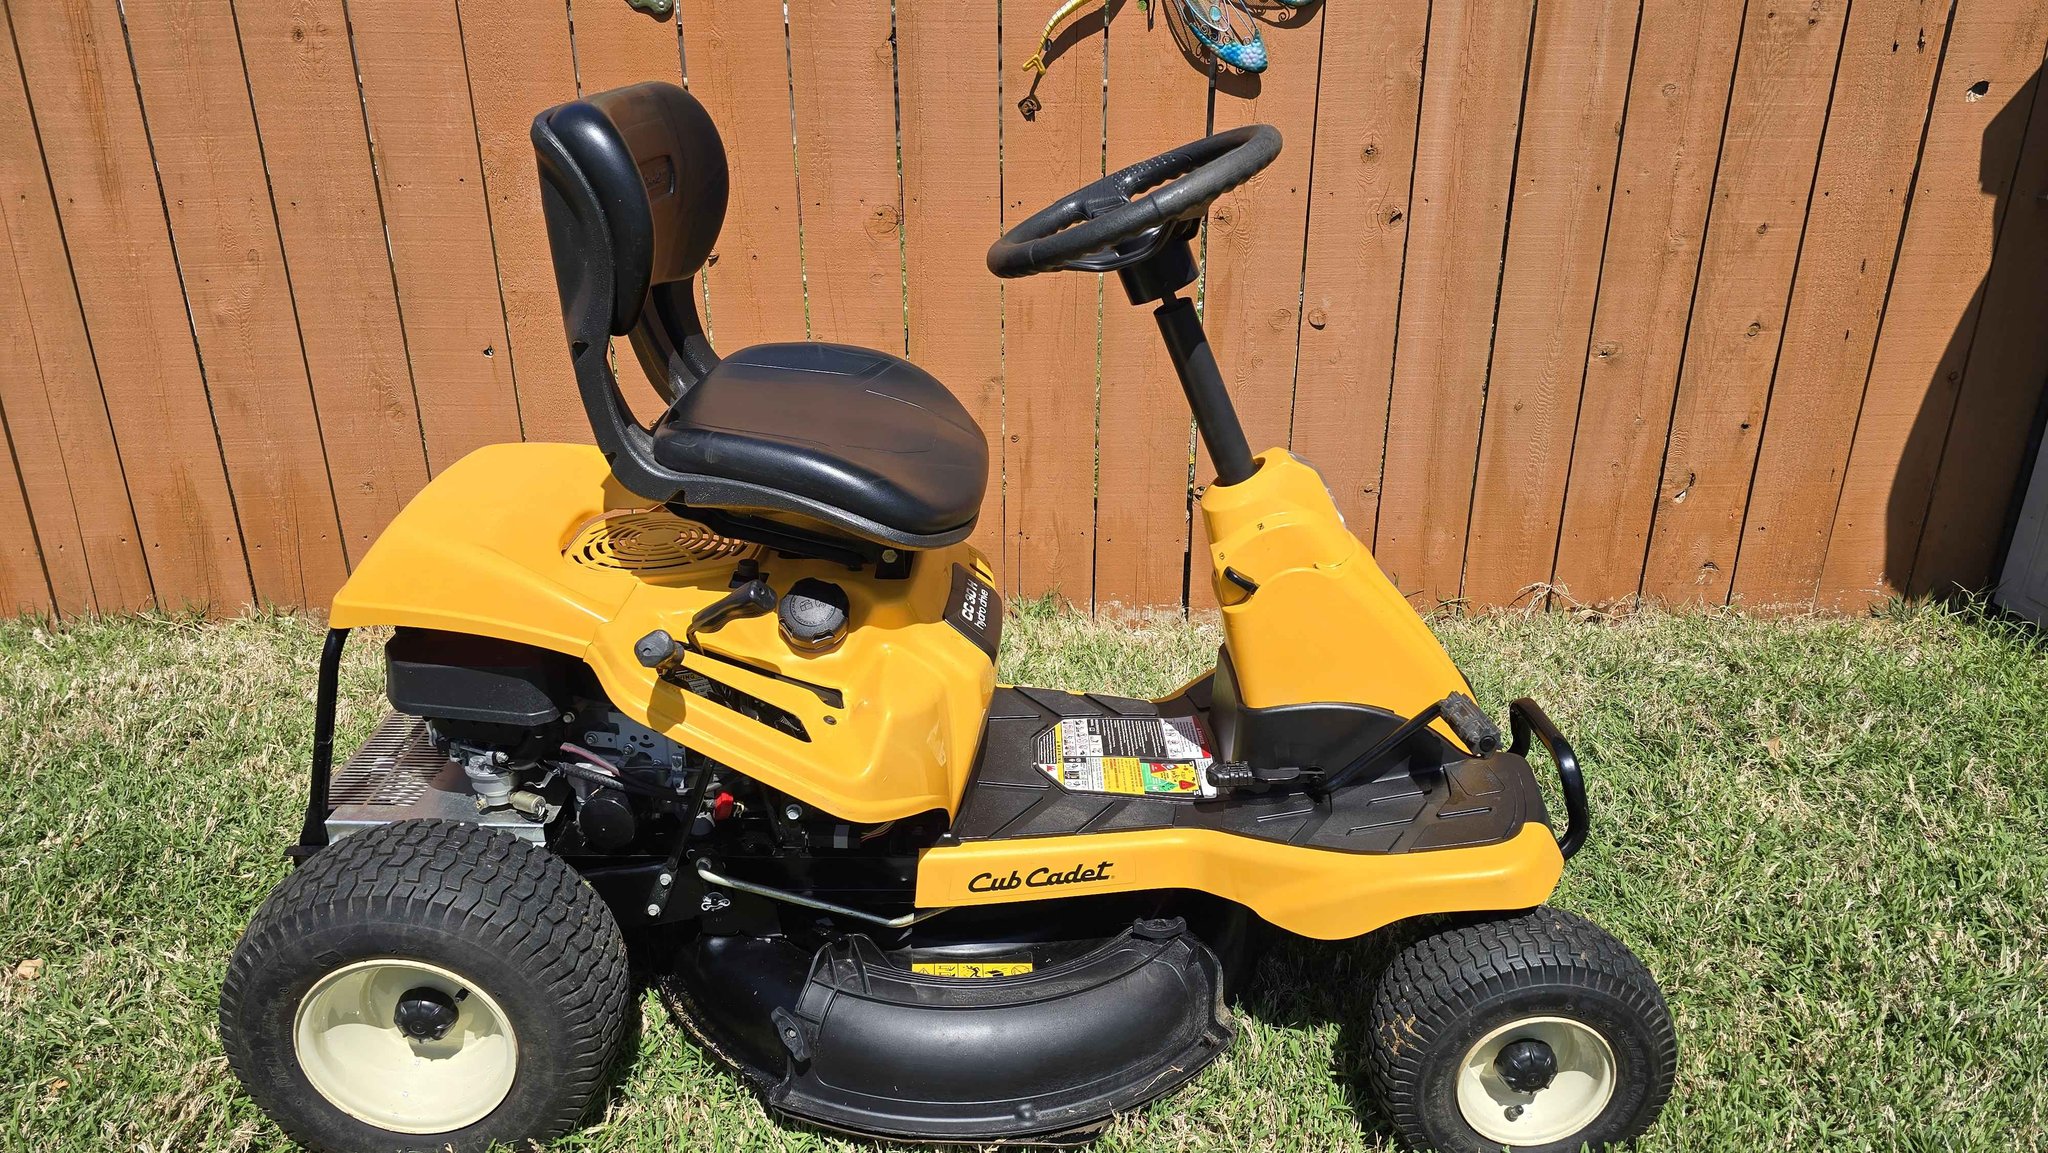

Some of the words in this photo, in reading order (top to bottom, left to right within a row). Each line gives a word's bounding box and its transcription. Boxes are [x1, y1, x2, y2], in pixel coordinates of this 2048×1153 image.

[967, 579, 978, 591] H
[978, 589, 989, 607] drive
[961, 602, 975, 622] CC
[974, 606, 987, 630] hydro
[967, 870, 1022, 893] Cub
[1025, 861, 1114, 887] Cadet
